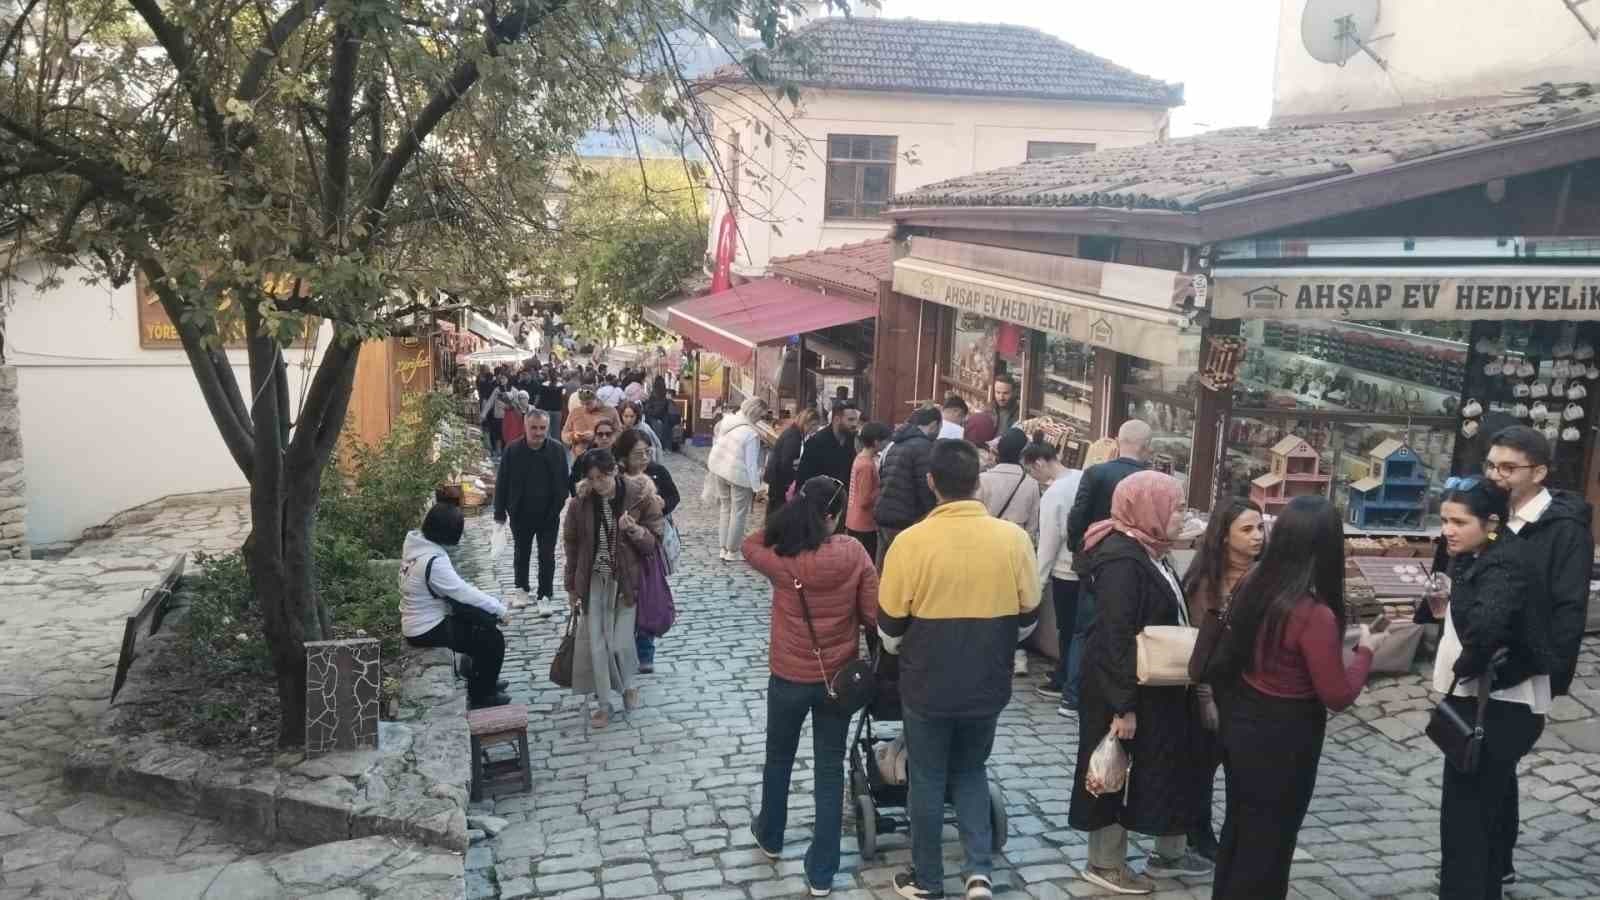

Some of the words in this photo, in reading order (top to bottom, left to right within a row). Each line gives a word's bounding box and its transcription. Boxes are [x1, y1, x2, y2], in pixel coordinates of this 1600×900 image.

[984, 294, 999, 314] EV
[1295, 284, 1392, 316] AHŞAP
[1402, 284, 1440, 309] EV
[148, 322, 178, 340] YÖRE
